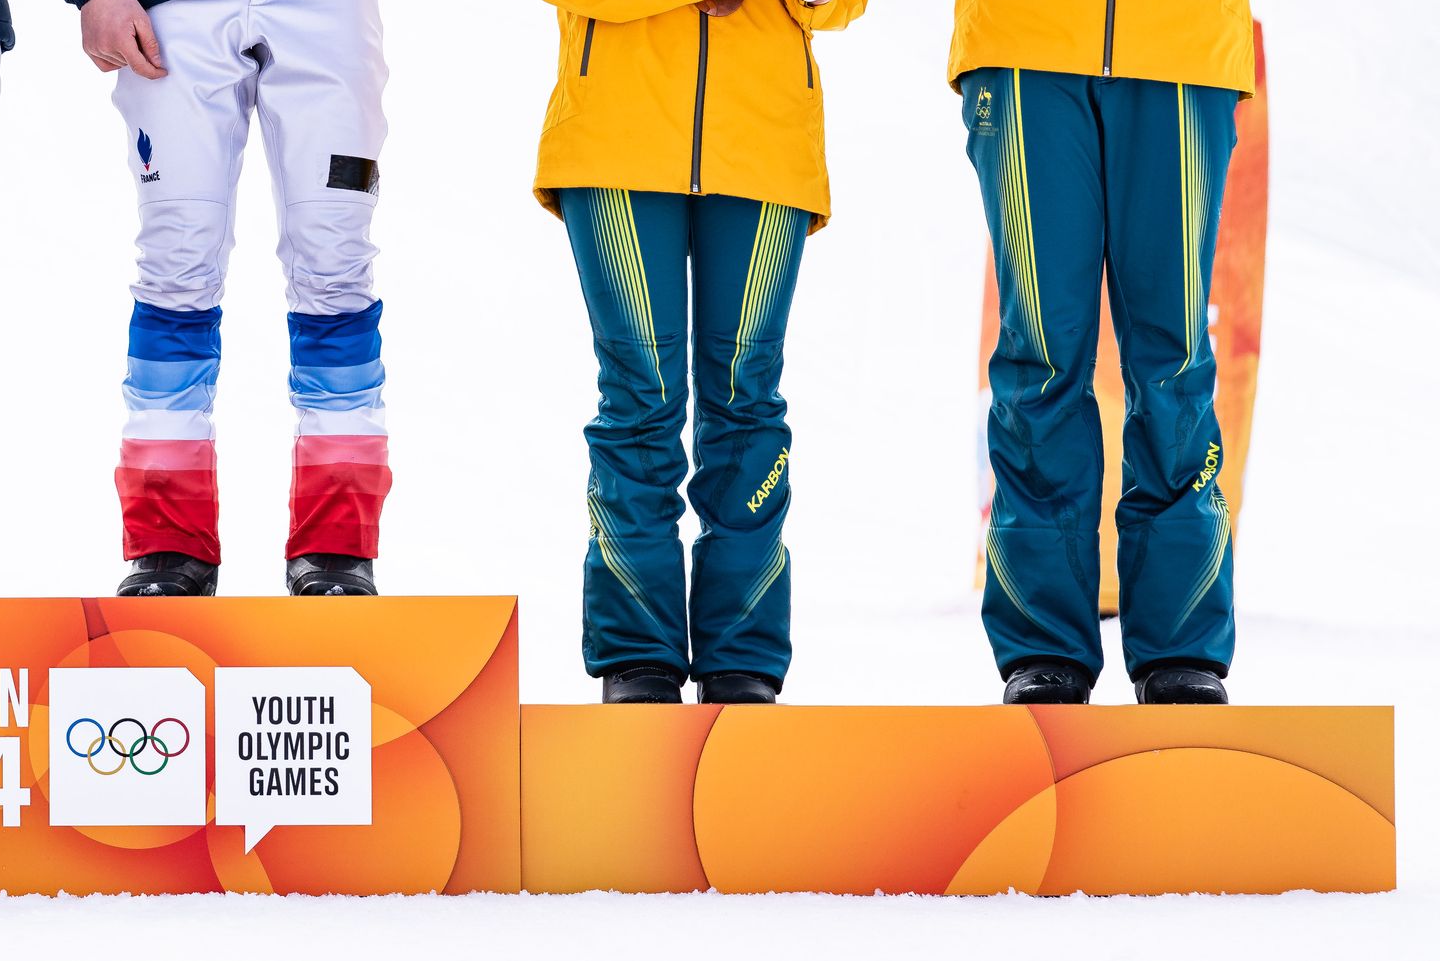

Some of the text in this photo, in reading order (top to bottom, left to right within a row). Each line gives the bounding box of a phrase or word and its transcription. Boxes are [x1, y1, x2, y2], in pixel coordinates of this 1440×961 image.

[140, 170, 160, 184] FRANCE
[746, 446, 789, 513] KARBON
[252, 696, 335, 725] YOUTH
[238, 731, 350, 761] OLYMPIC
[249, 767, 339, 796] GAMES
